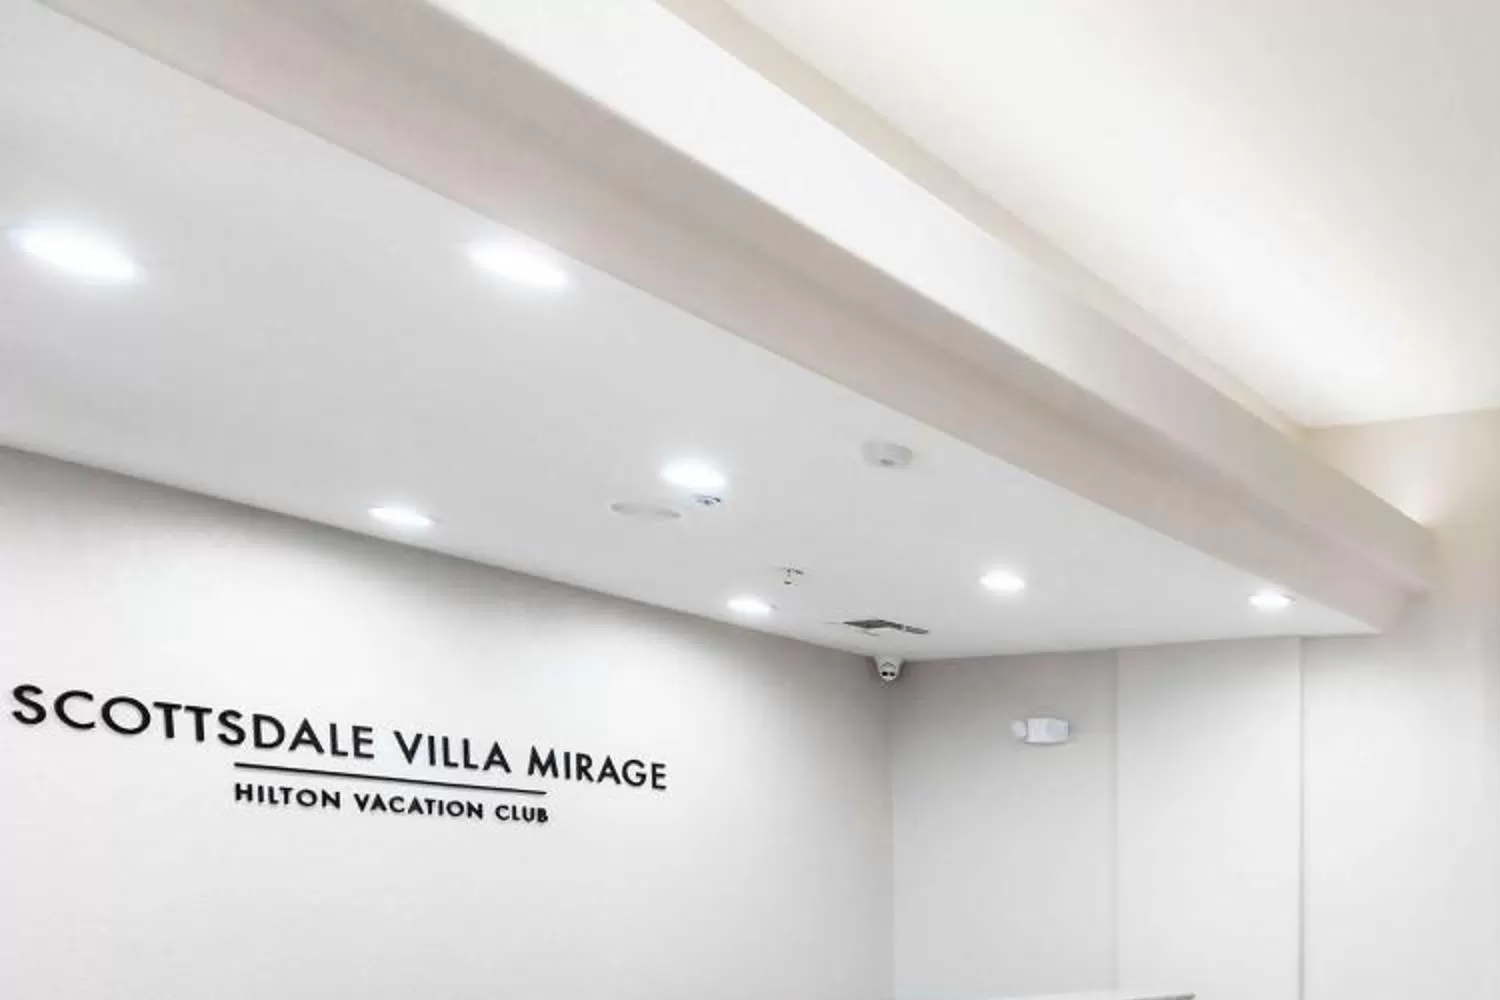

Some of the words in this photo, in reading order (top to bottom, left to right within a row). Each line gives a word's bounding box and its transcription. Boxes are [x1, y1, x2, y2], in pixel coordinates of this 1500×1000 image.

[11, 683, 376, 760] SCOTTSDALE
[393, 730, 513, 774] VILLA
[526, 745, 668, 791] MIRAGE
[233, 782, 342, 810] HILTON
[353, 792, 485, 820] VACATION
[494, 804, 550, 824] CLUB
